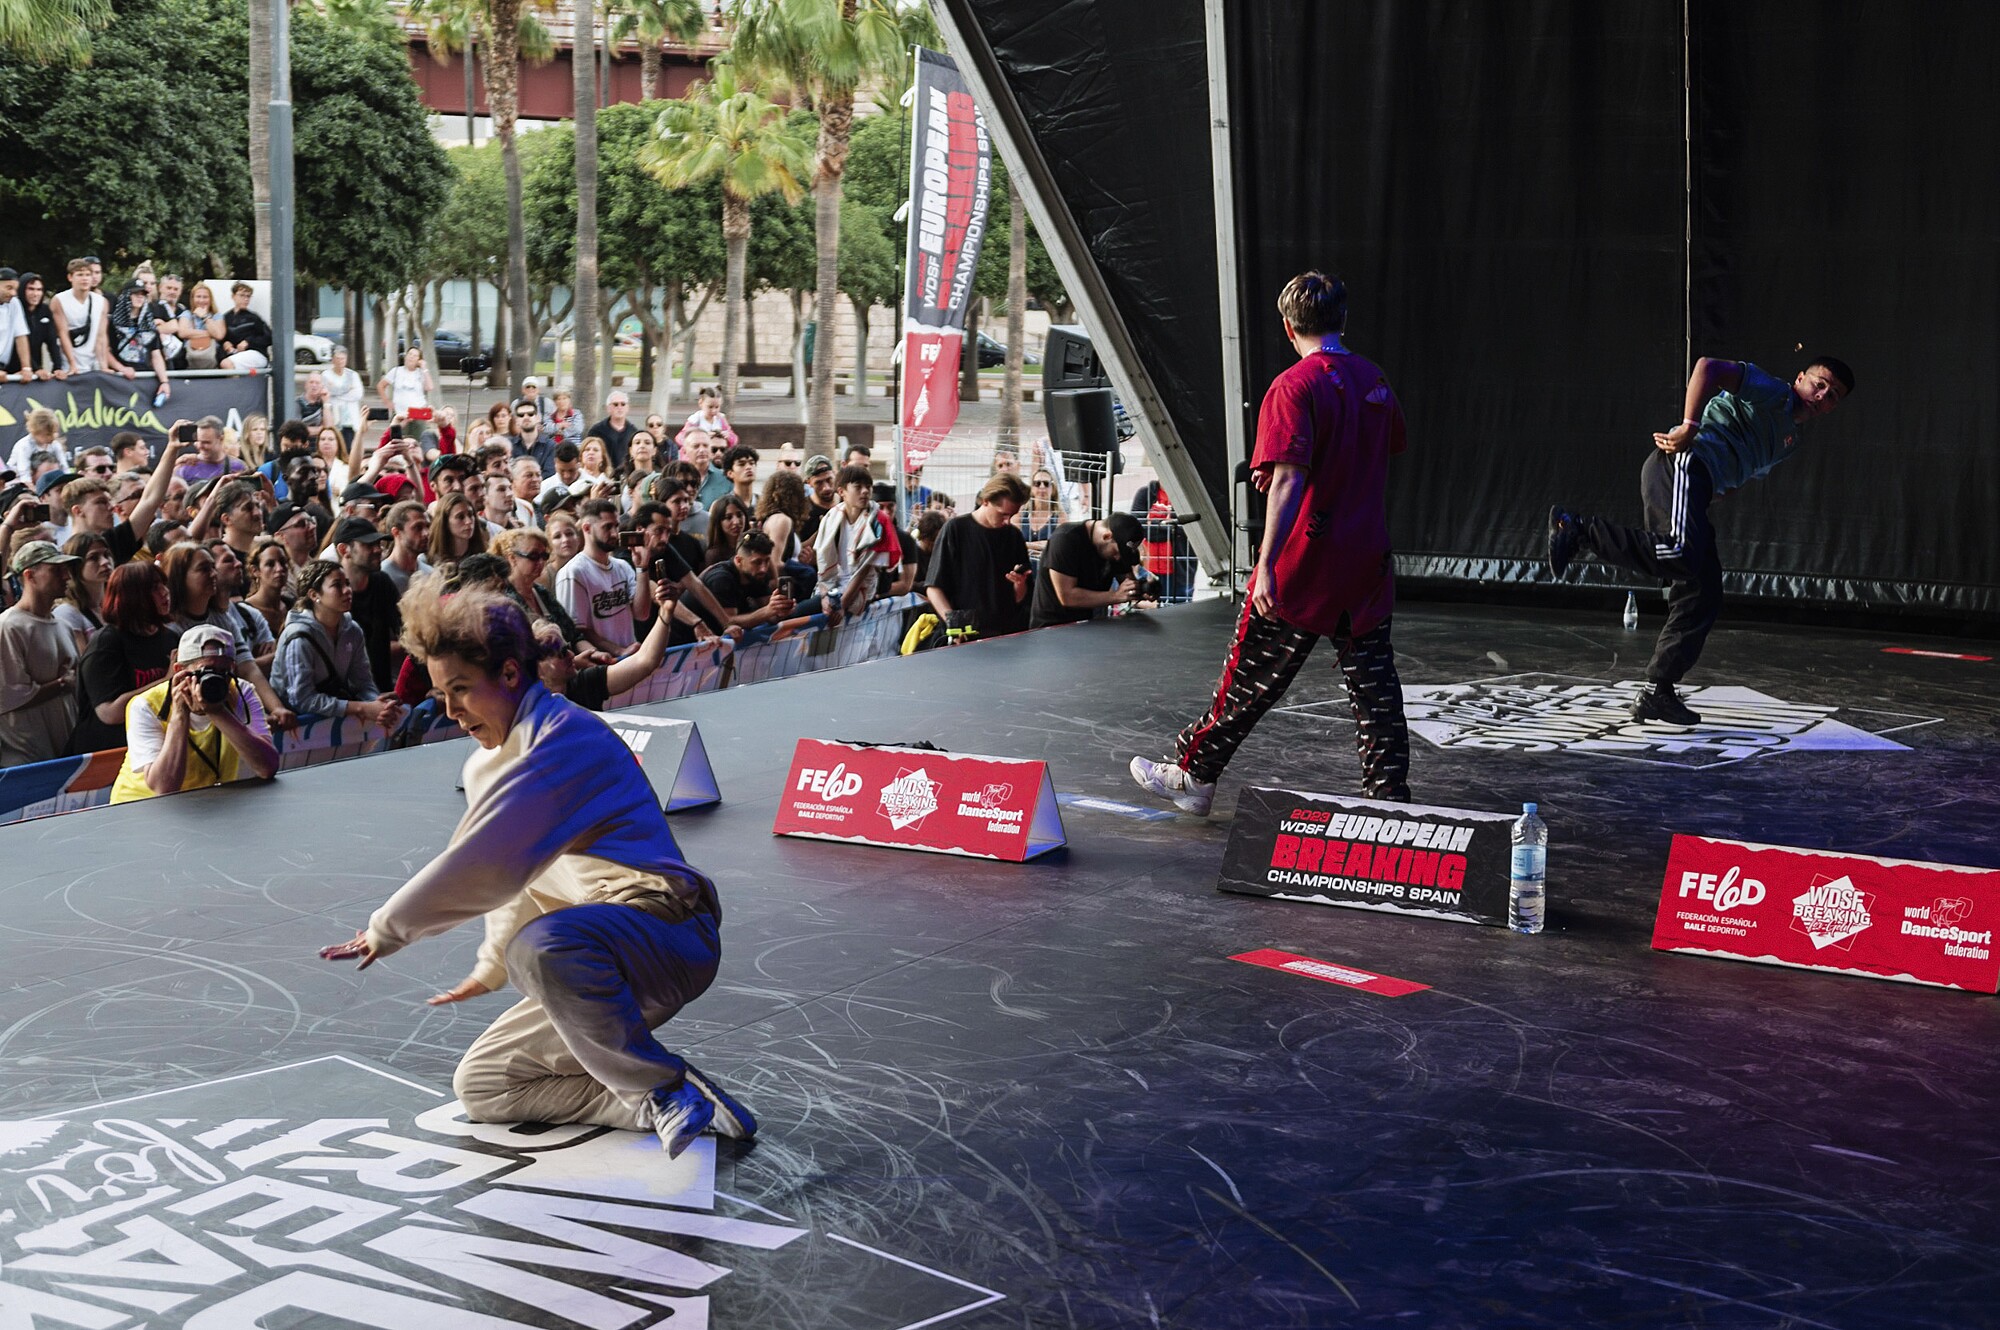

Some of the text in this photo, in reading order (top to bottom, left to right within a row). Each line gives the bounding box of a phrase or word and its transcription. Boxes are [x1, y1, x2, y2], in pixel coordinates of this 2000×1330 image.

[918, 86, 948, 308] WDSF EUROPEAN
[948, 156, 990, 310] CHAMPIONSHIPS
[894, 777, 936, 797] WDSF
[961, 787, 981, 803] world
[793, 801, 853, 814] FEDERACIÓN ESPAÑOLA
[880, 793, 938, 810] BREAKING
[815, 812, 845, 822] DEPORTIVO
[957, 803, 1023, 822] DanceSport
[1290, 808, 1331, 823] 2023
[987, 820, 1020, 834] federation
[1280, 812, 1475, 852] WDSF EUROPEAN
[1270, 833, 1468, 890] BREAKING
[1267, 869, 1461, 905] CHAMPIONSHIPS SPAIN
[1810, 886, 1865, 911] WDSF
[1676, 911, 1757, 928] FEDERACIÓN ESPAÑOLA
[1793, 904, 1871, 925] BREAKING
[1904, 906, 1930, 919] world
[1684, 921, 1747, 937] BAILE DEPORTIVO
[1901, 920, 1992, 945] DanceSport
[1944, 942, 1989, 960] federation
